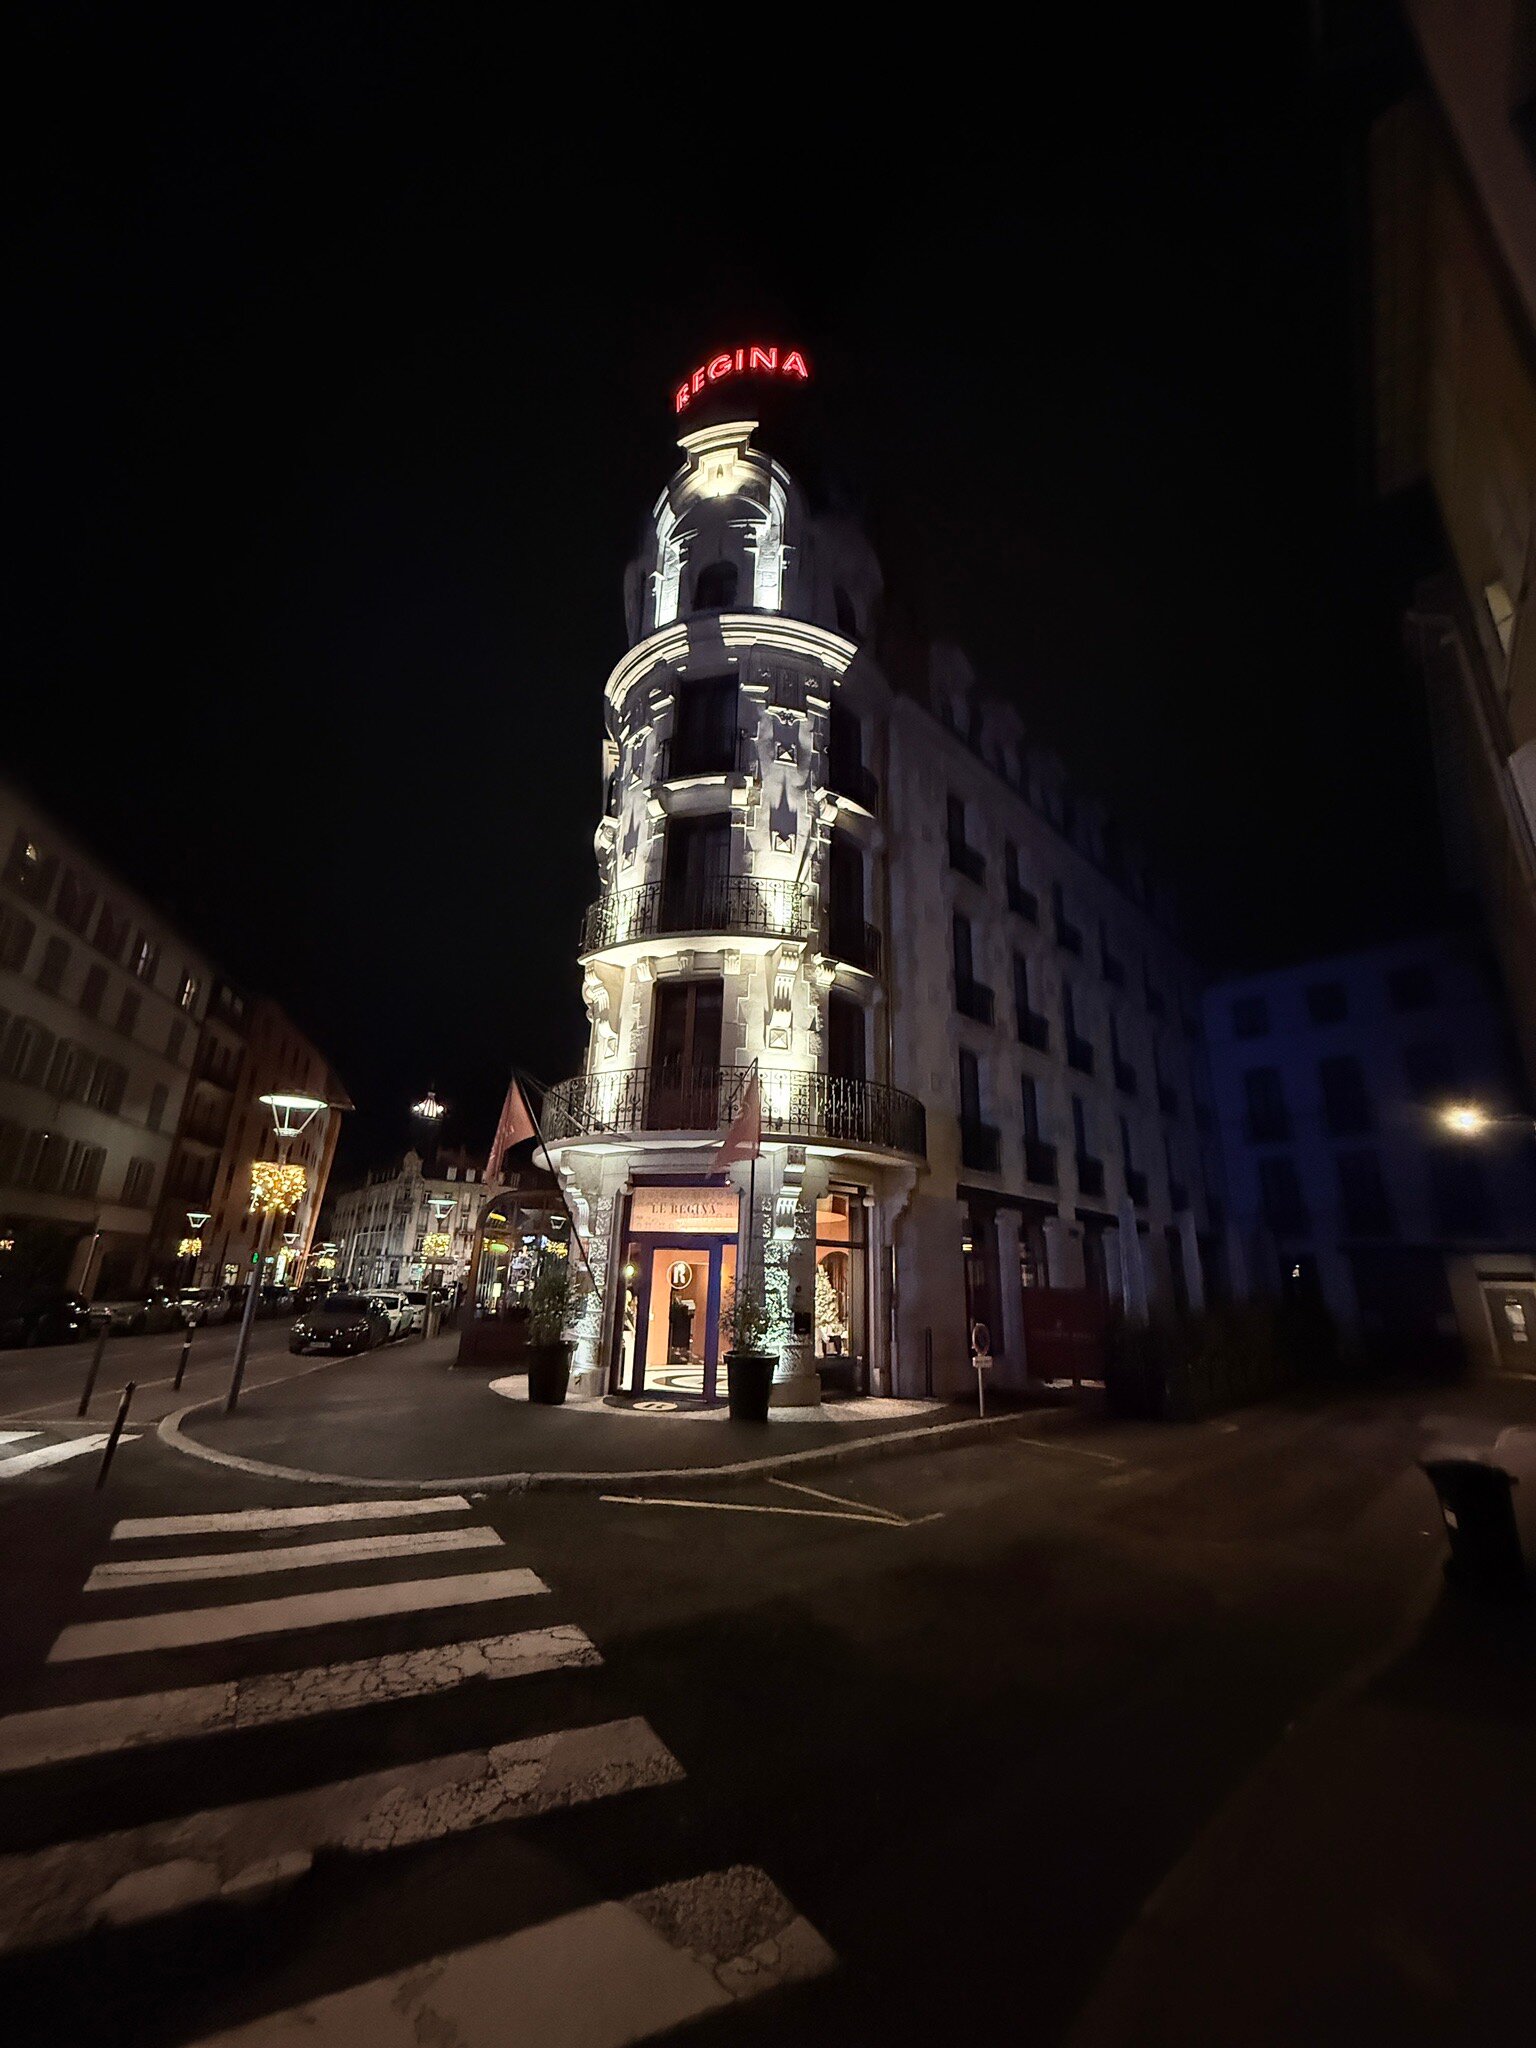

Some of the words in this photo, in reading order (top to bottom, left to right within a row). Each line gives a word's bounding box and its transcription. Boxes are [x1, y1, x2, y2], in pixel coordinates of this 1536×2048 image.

[675, 347, 809, 413] REGINA
[651, 1203, 667, 1214] LE
[671, 1203, 717, 1215] REGINA
[672, 1262, 687, 1285] R
